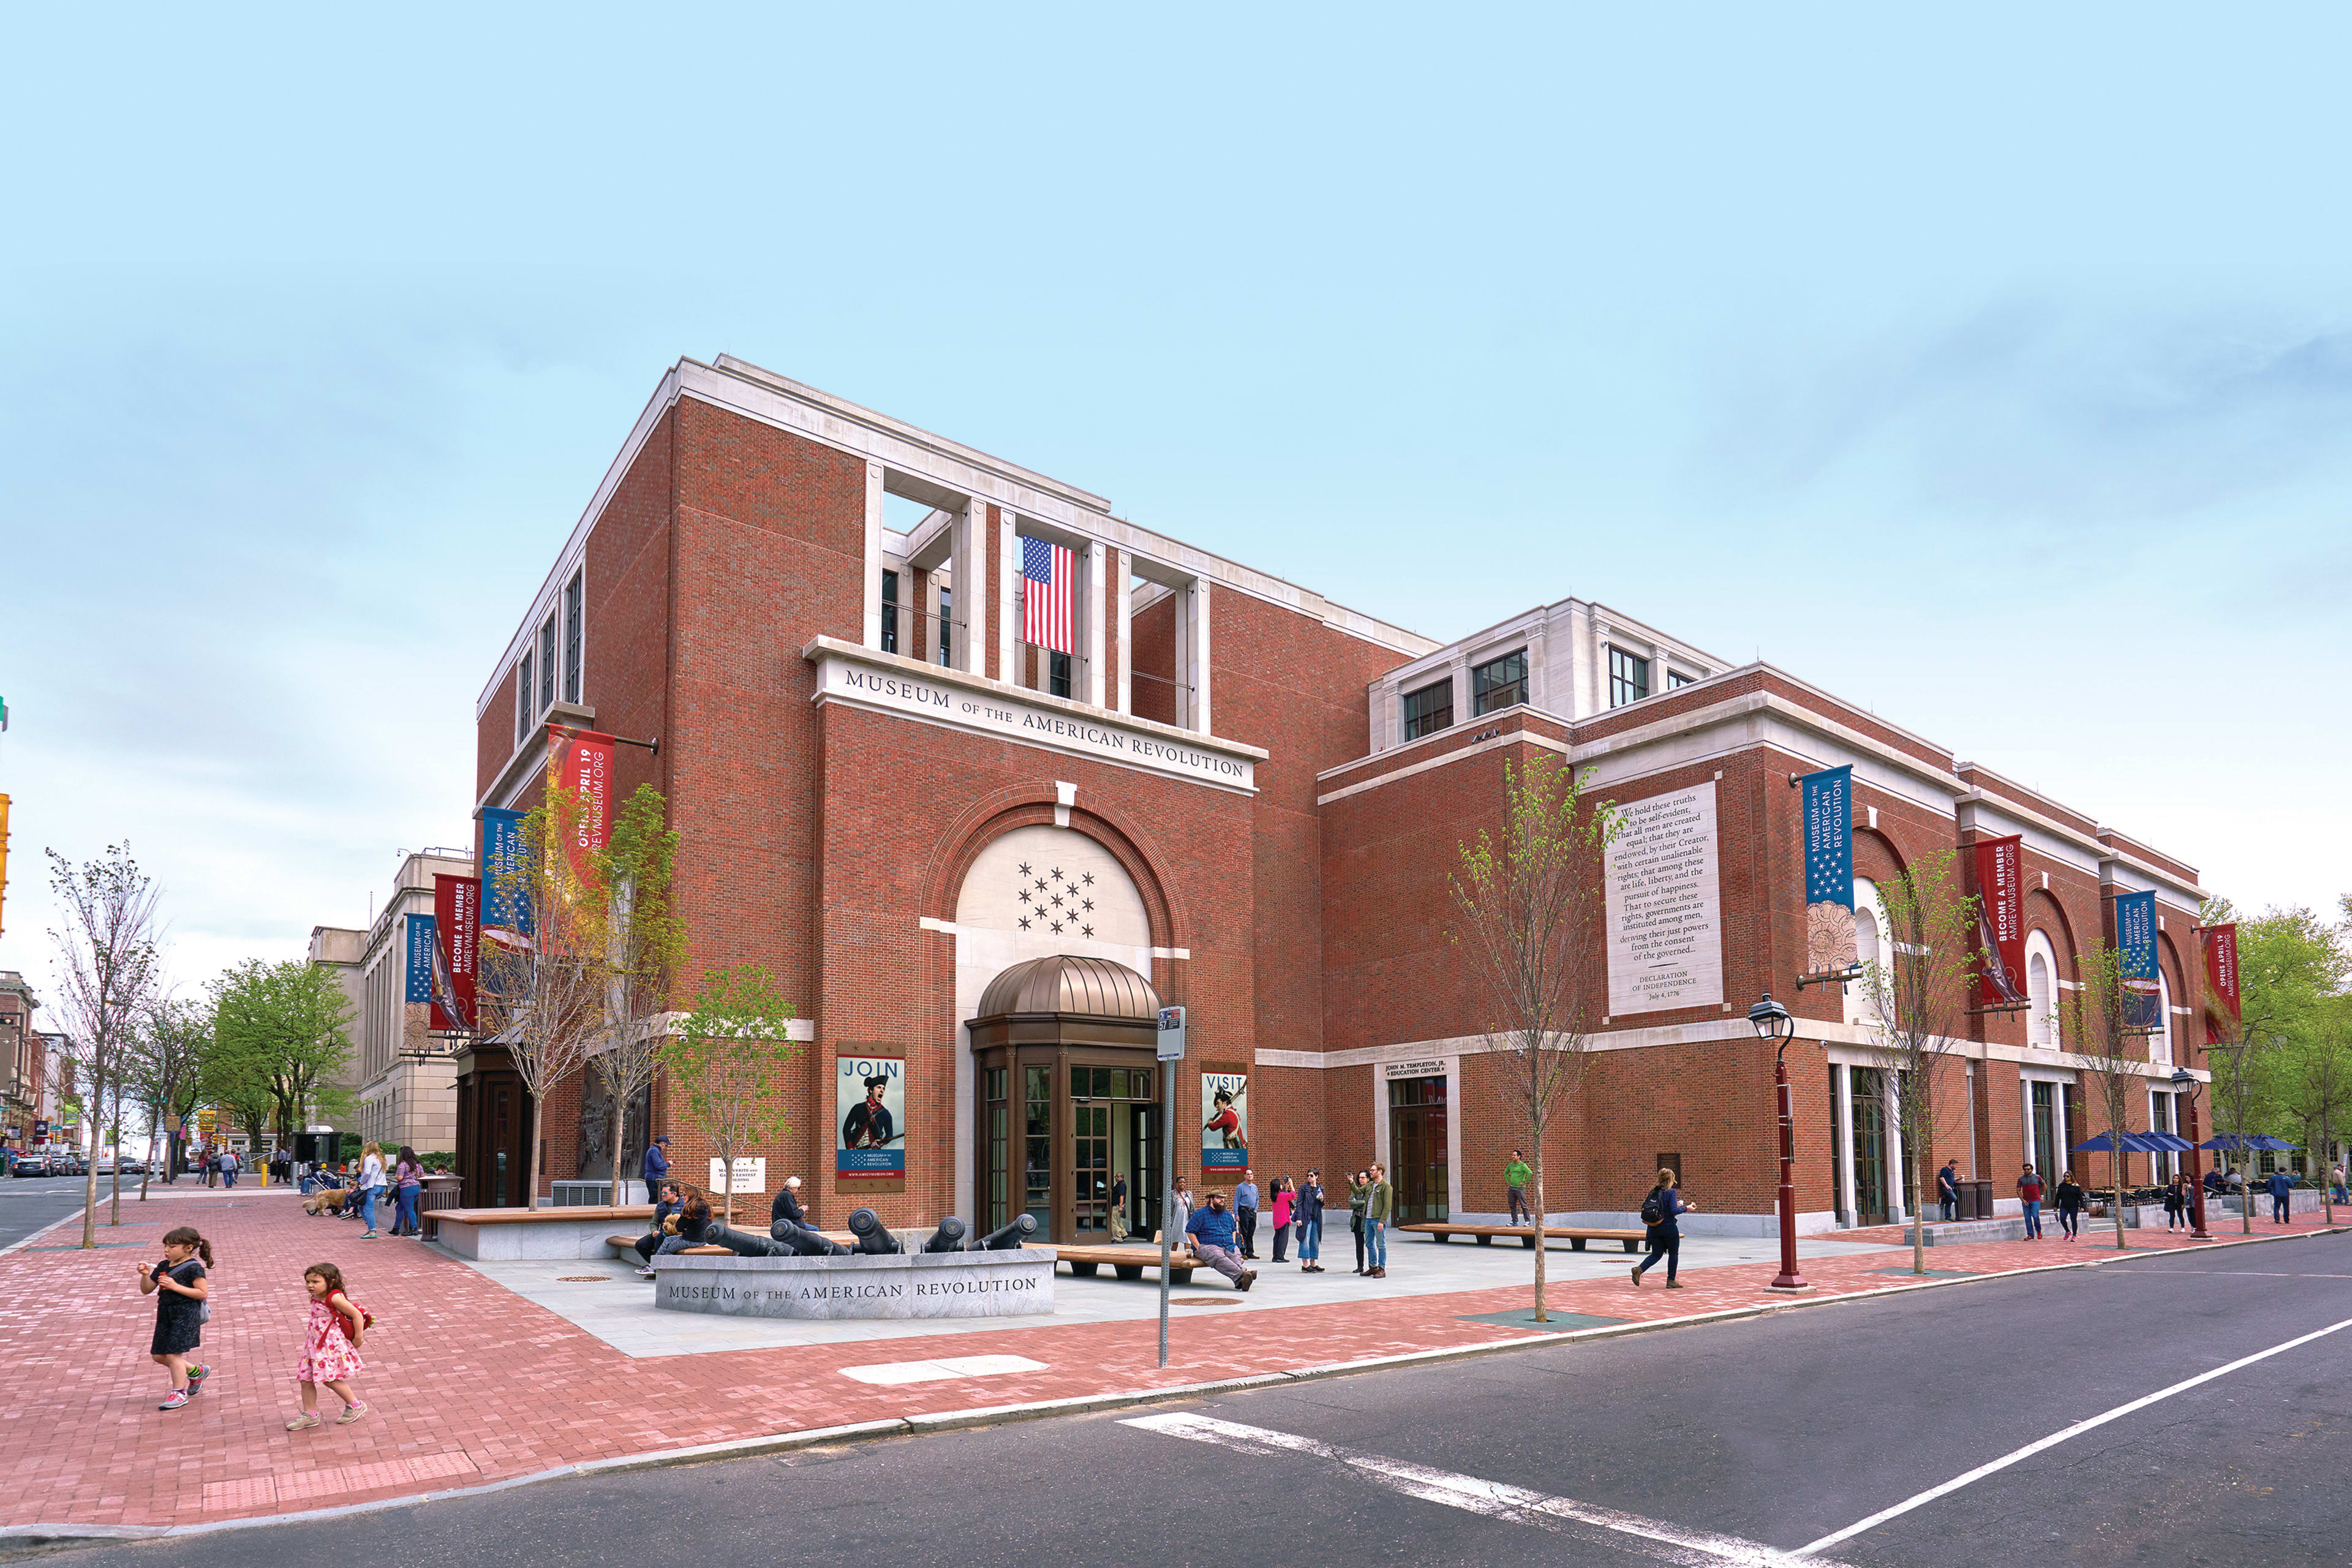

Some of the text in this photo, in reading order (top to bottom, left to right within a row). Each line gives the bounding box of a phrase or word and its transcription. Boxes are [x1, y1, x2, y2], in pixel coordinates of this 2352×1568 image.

[845, 669, 1243, 777] MUSEUM OF THE AMERICAN REVOLUTION
[581, 749, 591, 762] 19
[579, 768, 590, 802] APRIL
[1621, 794, 1696, 818] We hold these truths
[1649, 807, 1691, 822] self-evident,
[1812, 798, 1818, 807] OF
[1833, 779, 1842, 848] REVOLUTION
[1617, 831, 1632, 840] That
[1645, 824, 1660, 833] men
[1674, 813, 1701, 826] created
[1811, 808, 1820, 852] MUSEUM
[1822, 791, 1831, 849] AMERICAN
[1615, 835, 1709, 861] endowed, by their Creator,
[1626, 835, 1648, 848] equal;
[1649, 833, 1664, 842] that
[1665, 829, 1680, 840] they
[1617, 846, 1703, 870] with certain unalienable
[1996, 846, 2005, 886] MEMBER
[1618, 858, 1704, 883] rights; that among these
[1632, 878, 1646, 888] life,
[1648, 874, 1673, 884] liberty,
[1675, 869, 1689, 879] and
[455, 883, 464, 921] MEMBER
[1624, 890, 1649, 903] pursuit
[1661, 881, 1699, 895] happiness.
[1624, 903, 1642, 911] That
[1654, 897, 1676, 906] secure
[1679, 892, 1698, 901] these
[2006, 844, 2017, 940] AMREVMUSEUM.ORG
[1621, 913, 1643, 923] rights,
[1645, 904, 1691, 919] governments
[1623, 918, 1656, 931] instituted
[1658, 915, 1683, 925] among
[1998, 900, 2007, 941] BECOME
[2141, 901, 2149, 944] REVOLUTION
[464, 884, 475, 974] AMREVMUSEUM.ORG
[1620, 923, 1709, 943] deriving their just powers
[423, 929, 432, 968] AMERICAN
[1651, 940, 1662, 948] the
[1664, 935, 1695, 946] consent
[453, 935, 462, 973] BECOME
[2225, 934, 2234, 997] AMREVMUSEUM.ORG
[1640, 971, 1687, 983] DECLARATION
[1643, 978, 1697, 990] INDEPENDENCE
[1159, 1021, 1167, 1030] 57
[844, 1061, 897, 1077] JOIN
[1207, 1076, 1242, 1090] VISIT
[669, 1278, 1036, 1299] MUSEUM OF THE AMERICAN REVOLUTION
